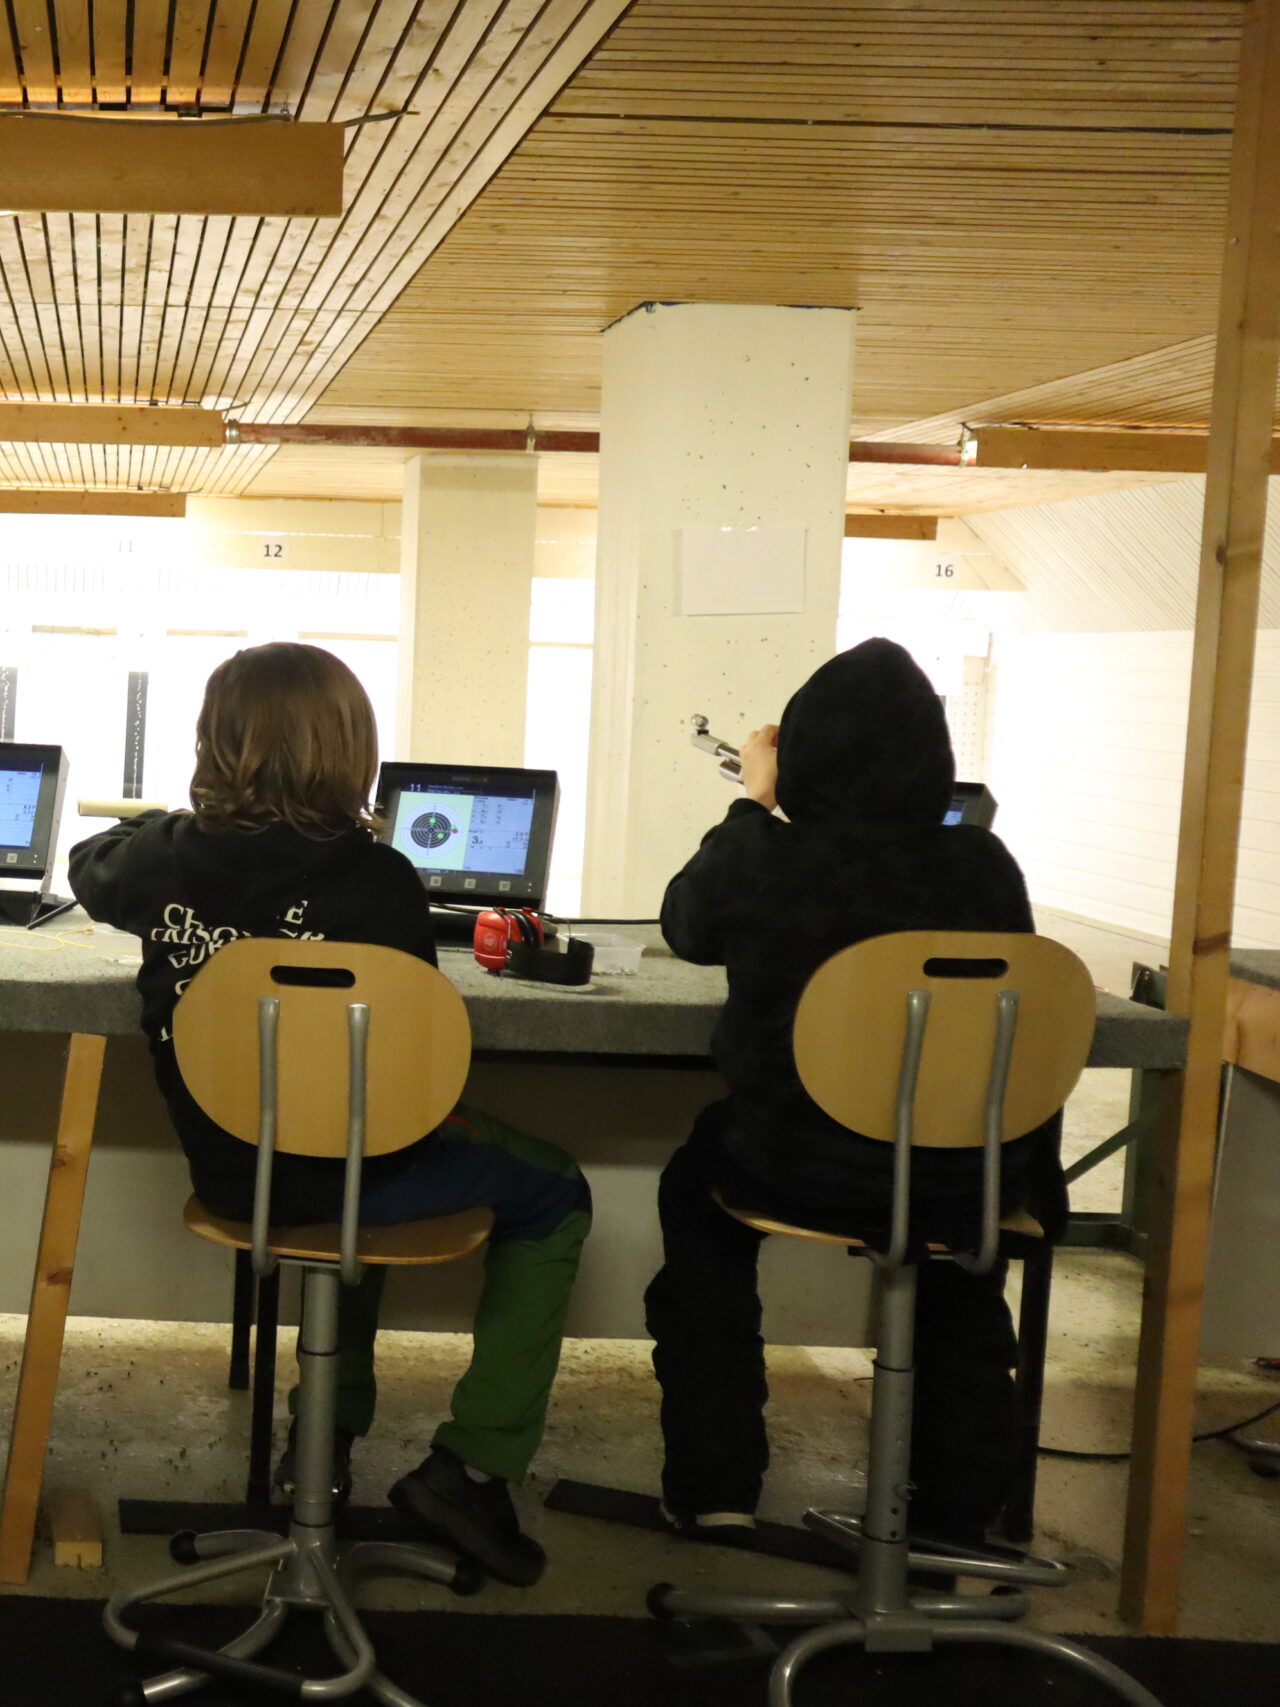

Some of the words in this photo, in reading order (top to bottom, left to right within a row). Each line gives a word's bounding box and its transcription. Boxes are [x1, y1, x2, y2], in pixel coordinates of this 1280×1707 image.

[263, 543, 283, 558] 12
[935, 563, 955, 578] 16
[410, 783, 422, 792] 11
